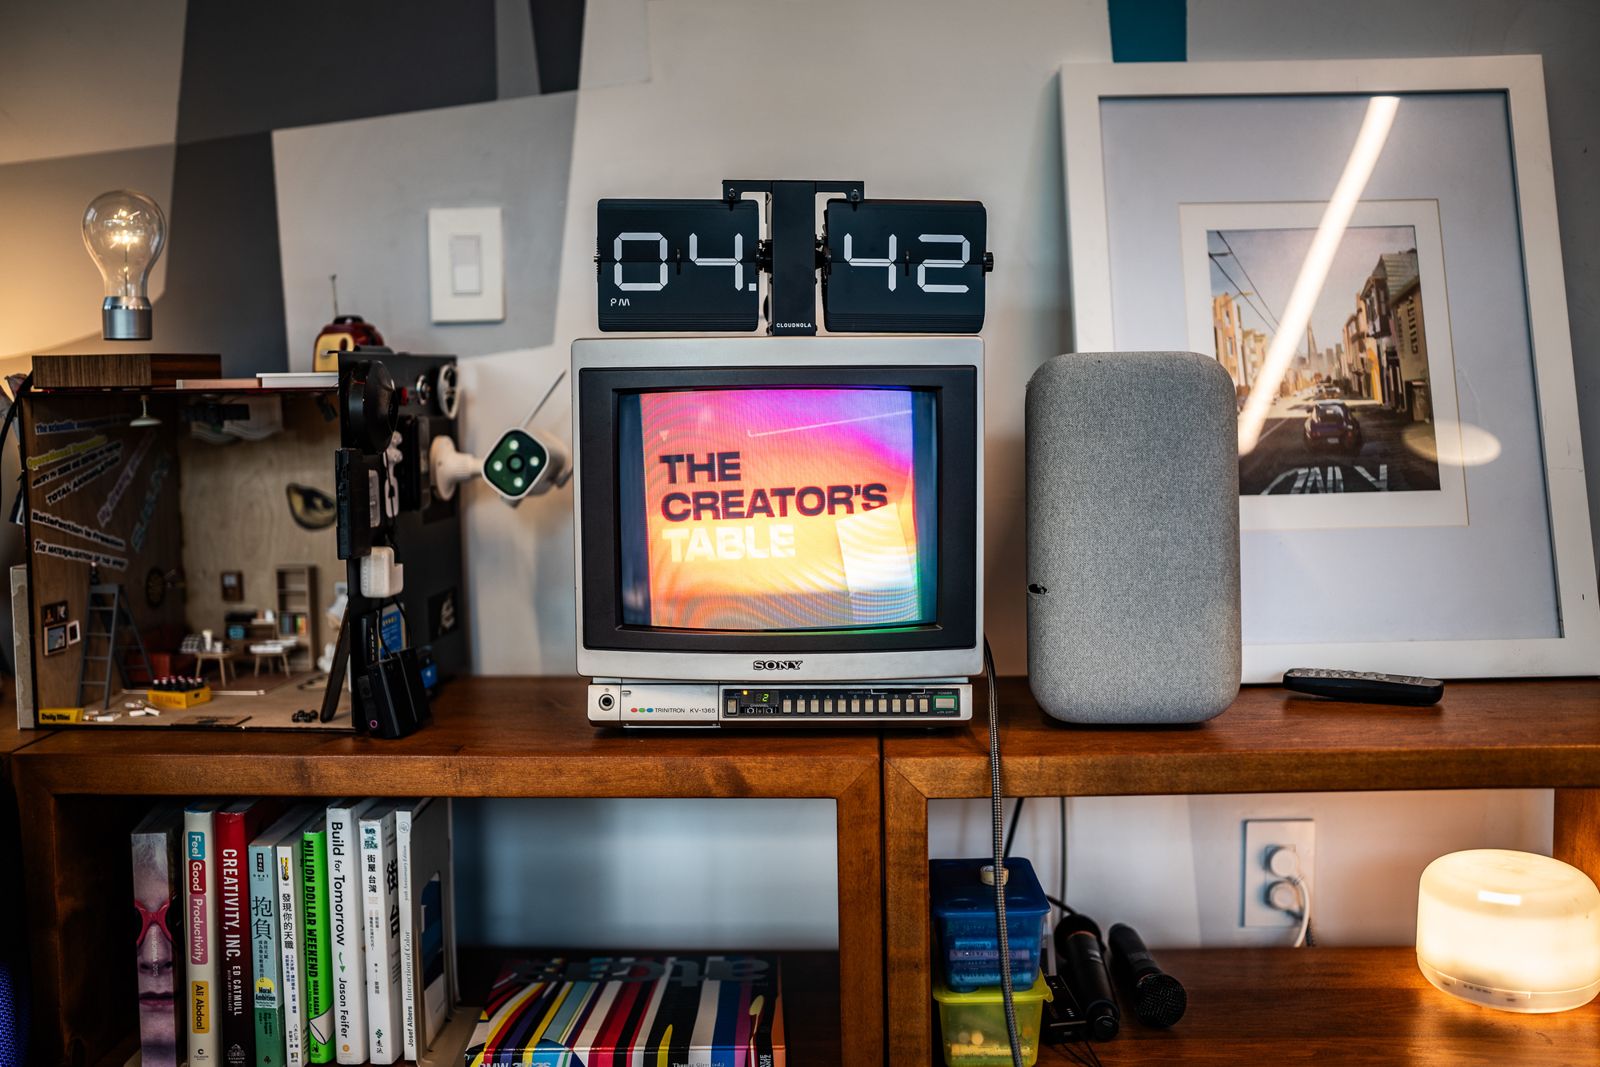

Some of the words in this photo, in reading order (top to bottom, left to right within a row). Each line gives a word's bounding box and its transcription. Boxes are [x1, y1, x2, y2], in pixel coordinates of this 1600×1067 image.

[843, 233, 971, 293] 42
[610, 298, 631, 307] PM
[659, 451, 741, 484] THE
[47, 485, 71, 504] TOTAL
[661, 483, 888, 522] CREATOR'S
[662, 524, 796, 563] TABLE
[753, 660, 804, 671] SONY
[191, 834, 202, 858] Feel
[331, 820, 344, 857] Build
[192, 861, 203, 892] Good
[304, 840, 315, 883] MILLION
[334, 860, 343, 873] for
[222, 848, 240, 930] CREATIVITY,
[305, 885, 316, 926] DOLLAR
[252, 896, 273, 940] 抱負
[282, 893, 294, 949] 發現你的天職
[333, 874, 346, 946] Tomorrow
[192, 898, 204, 963] Productivity
[225, 934, 241, 962] INC.
[232, 965, 241, 976] ED
[306, 928, 319, 978] WEEKEND
[404, 952, 411, 961] of
[195, 984, 204, 999] Ali
[233, 979, 243, 1016] CATMULL
[338, 977, 347, 1007] Jason
[405, 961, 413, 1002] Interaction
[195, 1001, 205, 1030] Abdaal
[340, 1009, 349, 1038] Feifer
